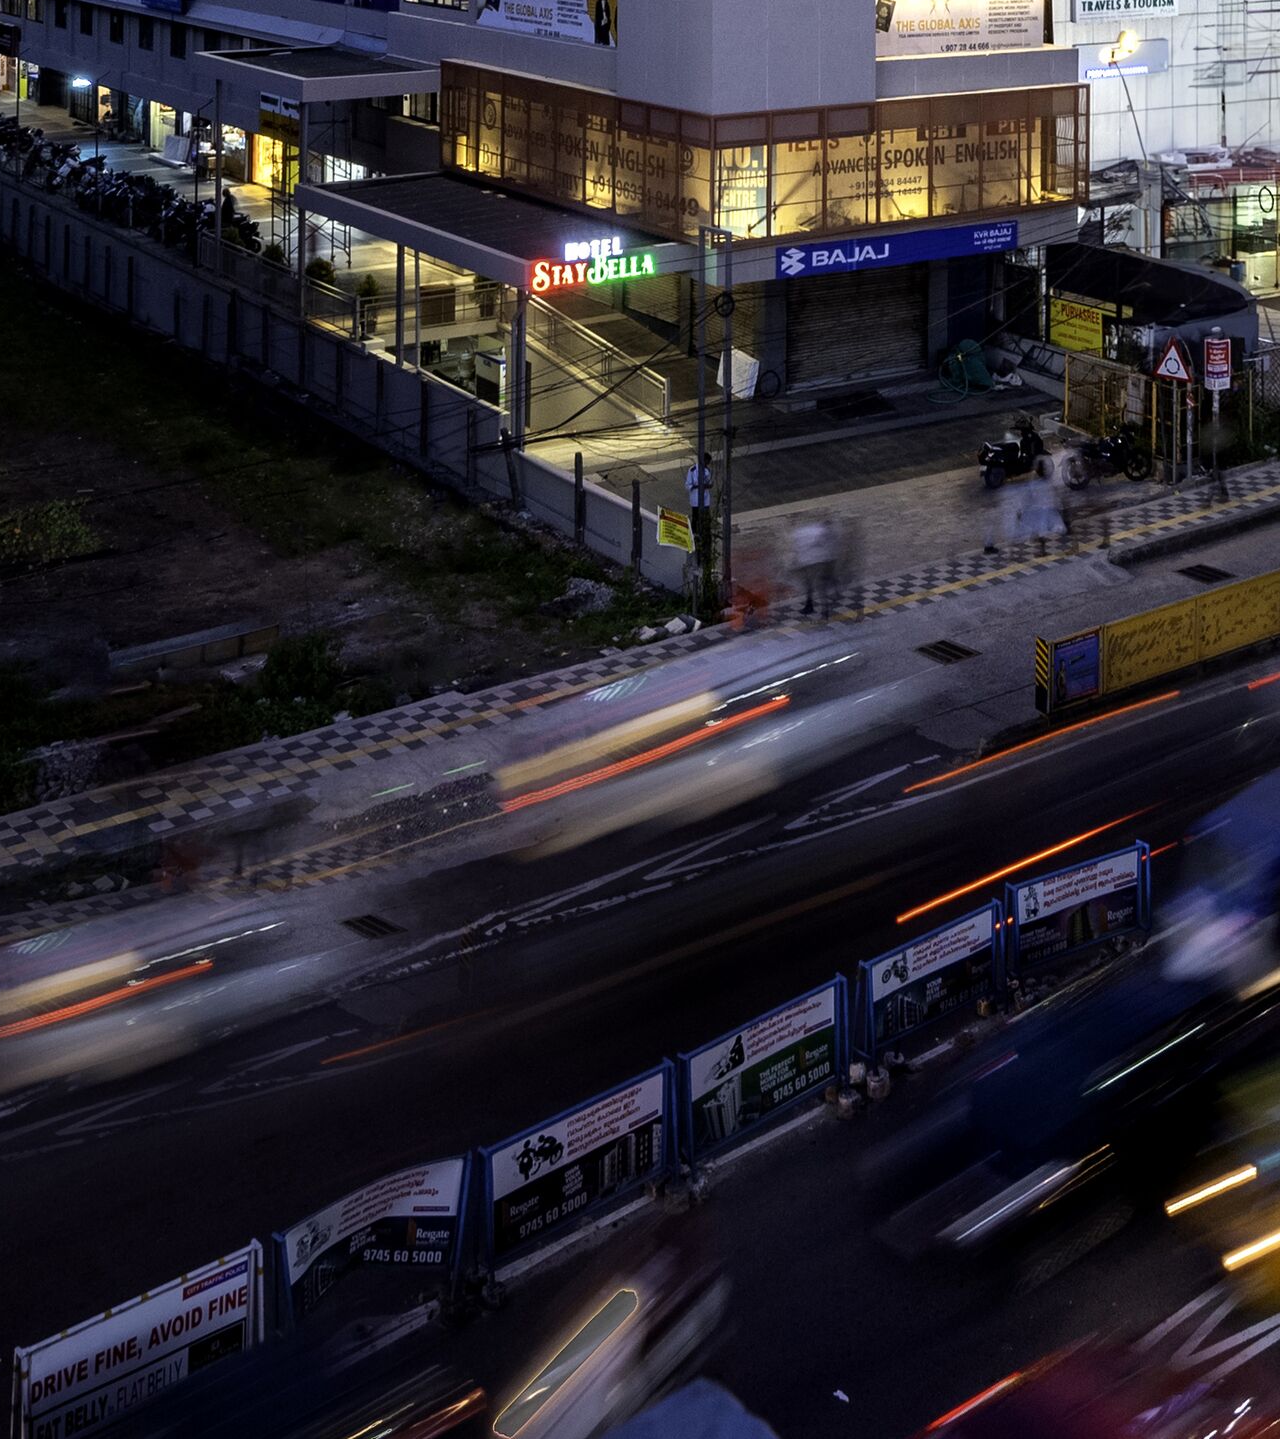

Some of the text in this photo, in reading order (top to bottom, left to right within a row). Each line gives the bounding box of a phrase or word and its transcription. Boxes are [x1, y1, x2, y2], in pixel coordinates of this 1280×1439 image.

[504, 2, 554, 20] THE GLOBAL AXIS
[1081, 0, 1121, 12] TRAVELS
[1124, 0, 1131, 9] &
[896, 18, 980, 32] THE GLOBAL AXIS
[945, 44, 957, 52] 907
[551, 129, 599, 163] SPOKEN
[608, 143, 666, 180] ENGLISH
[884, 144, 946, 170] SPOKEN
[955, 139, 1017, 164] ENGLISH
[973, 227, 1012, 240] KVR BAJAJ
[565, 236, 623, 261] HOTEL
[812, 243, 890, 267] BAJAJ
[773, 1061, 830, 1104] 9745 60 5000
[510, 1195, 540, 1217] Reigate
[519, 1191, 588, 1239] 9745 60 5000
[416, 1228, 450, 1241] Reigate
[363, 1249, 442, 1264] 9745 60 5000
[186, 1262, 247, 1297] CITY TRAFFIC POLICE
[30, 1285, 248, 1404] DRIVE FINE, AVOID FINE
[36, 1357, 183, 1439] FAT BELLY FLAT BELLY
